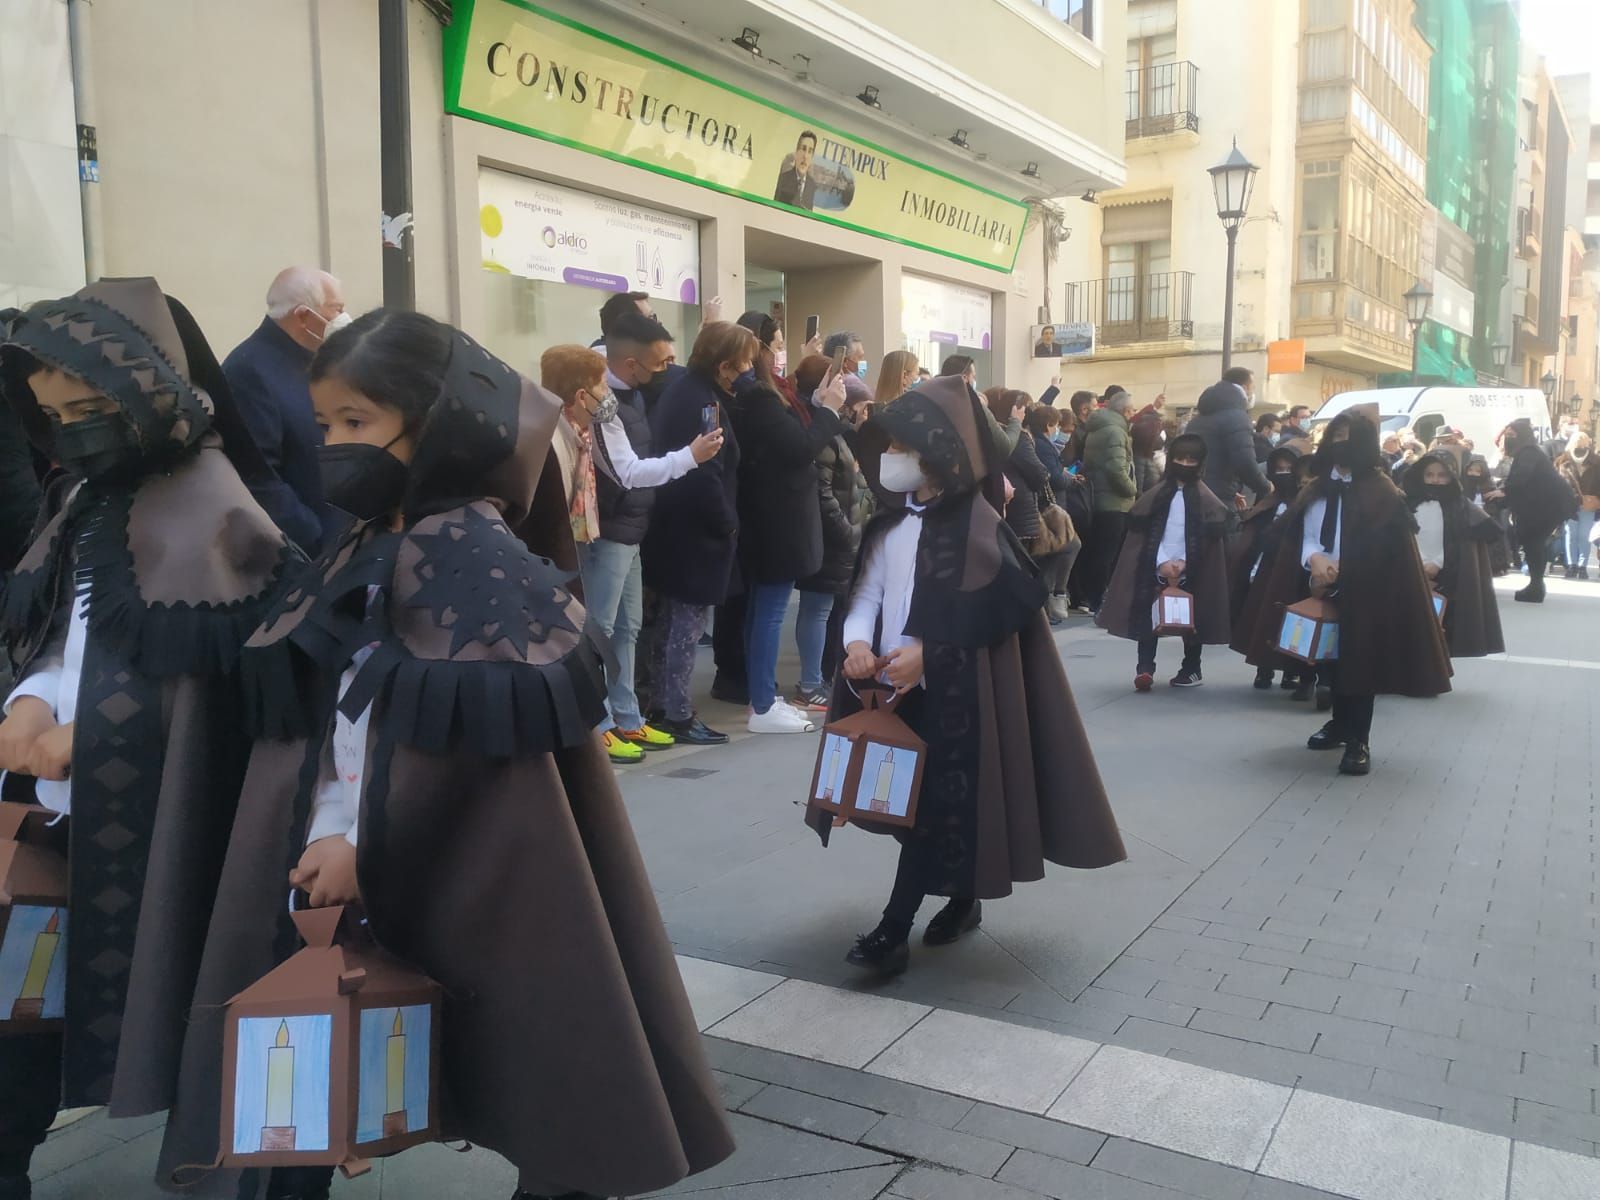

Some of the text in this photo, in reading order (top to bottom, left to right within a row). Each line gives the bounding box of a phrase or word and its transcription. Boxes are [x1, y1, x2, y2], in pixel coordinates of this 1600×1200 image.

[487, 42, 753, 160] CONSTRUCTORA
[822, 137, 891, 181] TTEMPUX
[557, 231, 588, 250] aldro
[900, 189, 1013, 246] INMOBILIARIA
